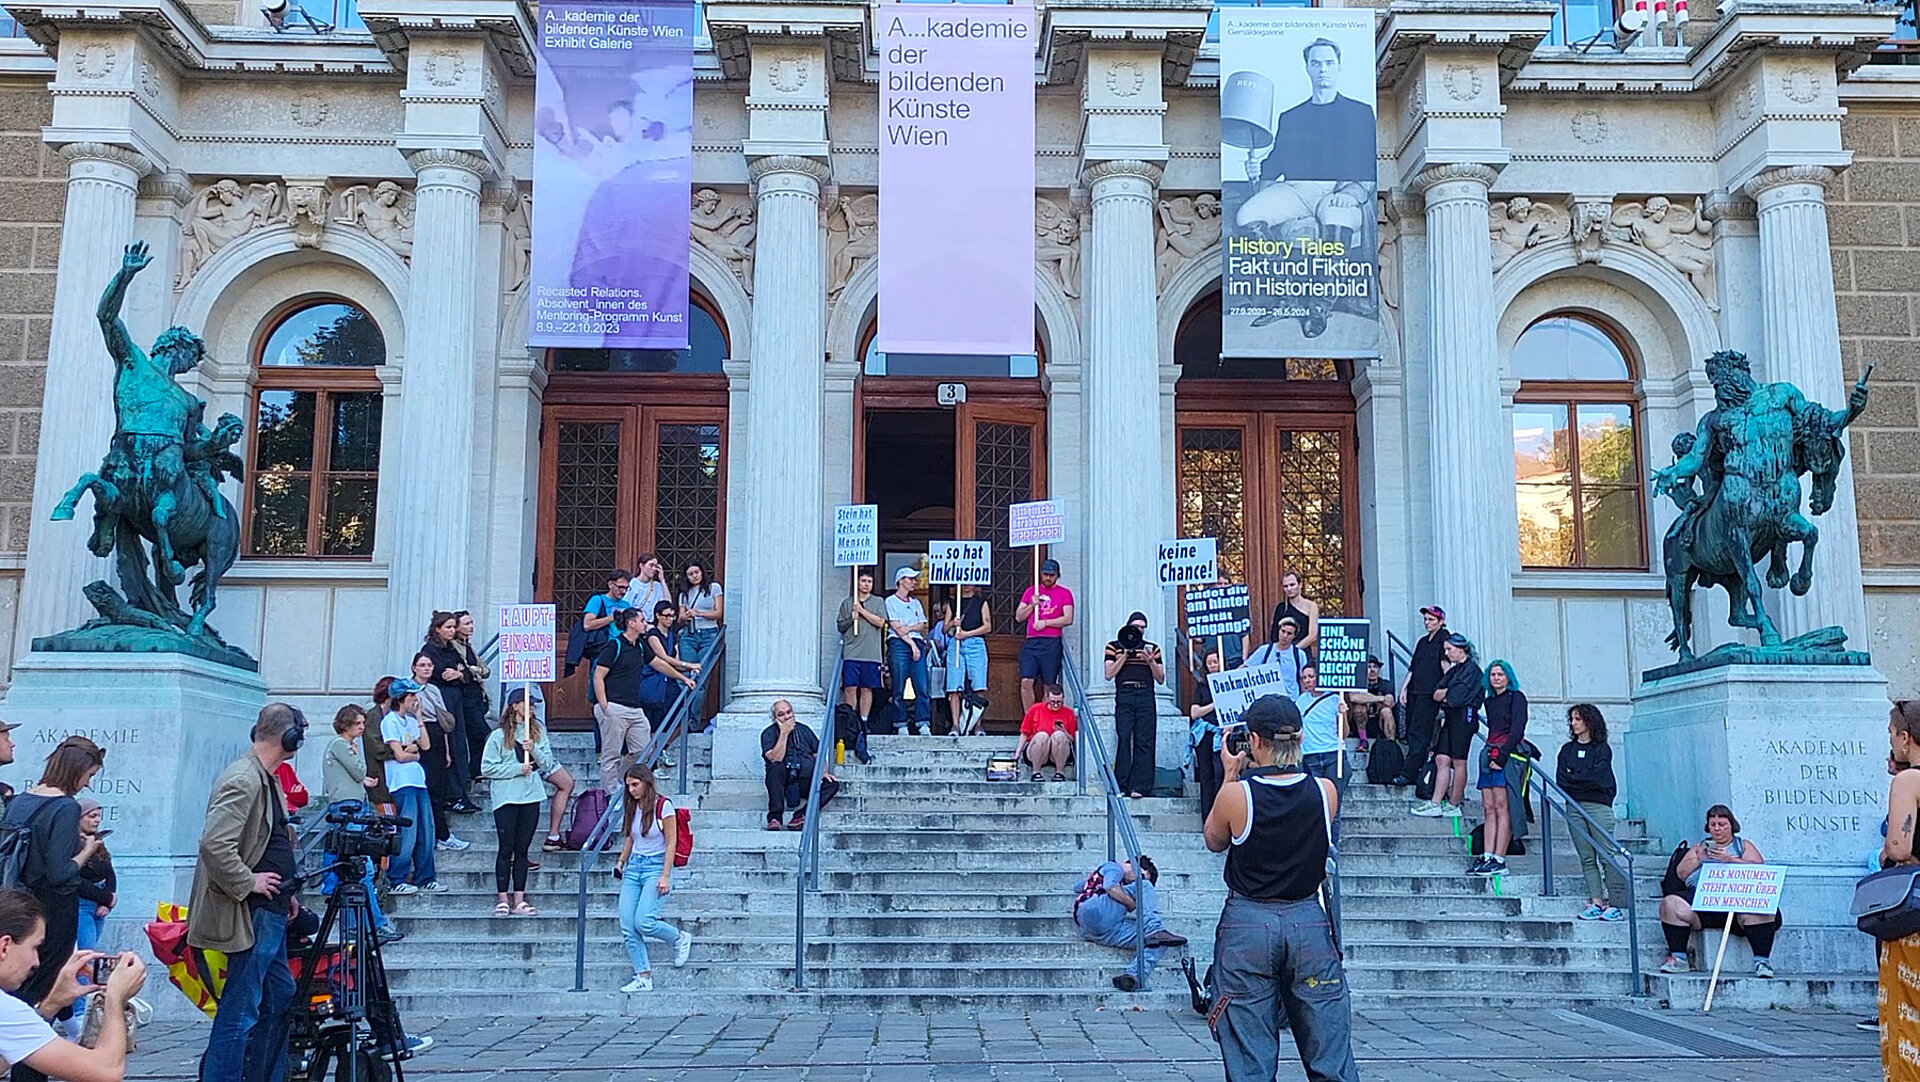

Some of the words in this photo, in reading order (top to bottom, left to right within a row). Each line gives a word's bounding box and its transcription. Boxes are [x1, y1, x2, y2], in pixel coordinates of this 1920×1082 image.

[545, 10, 615, 22] A...kademie
[619, 11, 640, 23] der
[545, 23, 603, 35] bildenden
[607, 24, 649, 36] Künste
[652, 26, 684, 37] Wien
[888, 17, 1027, 38] A...kademie
[545, 37, 586, 48] Exhibit
[589, 38, 633, 49] Galerie
[888, 44, 927, 64] der
[888, 71, 1004, 92] bildenden
[888, 97, 970, 119] Künste
[887, 125, 948, 145] Wien
[1228, 236, 1293, 259] History
[1296, 237, 1344, 256] Tales
[1229, 257, 1269, 275] Fakt
[1273, 258, 1308, 275] und
[1312, 258, 1372, 276] Fiktion
[537, 286, 587, 297] Recasted
[591, 287, 642, 298] Relations.
[1229, 277, 1251, 295] im
[1256, 278, 1368, 297] Historienbild
[537, 299, 625, 312] Absolvent_innen
[627, 299, 648, 310] des
[536, 310, 649, 324] Mentoring-Programm
[652, 311, 683, 323] Kunst
[947, 384, 956, 398] 3
[838, 508, 858, 520] Stein
[860, 508, 872, 519] hat
[857, 522, 870, 532] der
[838, 536, 870, 547] Mensch
[838, 550, 870, 562] nicht!!!
[946, 547, 960, 560] so
[963, 544, 983, 560] hat
[1158, 543, 1197, 560] keine
[931, 561, 989, 582] Inklusion
[1160, 560, 1213, 583] Chance!
[1187, 600, 1207, 612] am
[1209, 595, 1250, 610] hinter
[1188, 618, 1251, 636] eingang?
[1320, 625, 1345, 637] EINE
[500, 633, 553, 652] EINGANG
[1320, 636, 1365, 650] SCHÖNE
[1319, 650, 1367, 662] FASSADE
[502, 653, 522, 680] FÜR
[523, 656, 551, 680] ALLE!
[1319, 662, 1357, 674] REICHT
[1212, 669, 1280, 694] Denkmalschutz
[1318, 675, 1356, 687] NICHT!
[1243, 690, 1256, 703] ist
[1765, 740, 1867, 755] AKADEMIE
[1800, 764, 1838, 780] DER
[1765, 789, 1878, 805] BILDENDEN
[1786, 813, 1861, 831] KÜNSTE
[1708, 869, 1726, 879] DAS
[1726, 869, 1778, 881] MONUMENT
[1700, 882, 1727, 893] STEHT
[1727, 883, 1754, 894] NICHT
[1755, 881, 1778, 895] ÜBER
[1702, 896, 1721, 906] DEN
[1721, 896, 1770, 909] MENSCHEN
